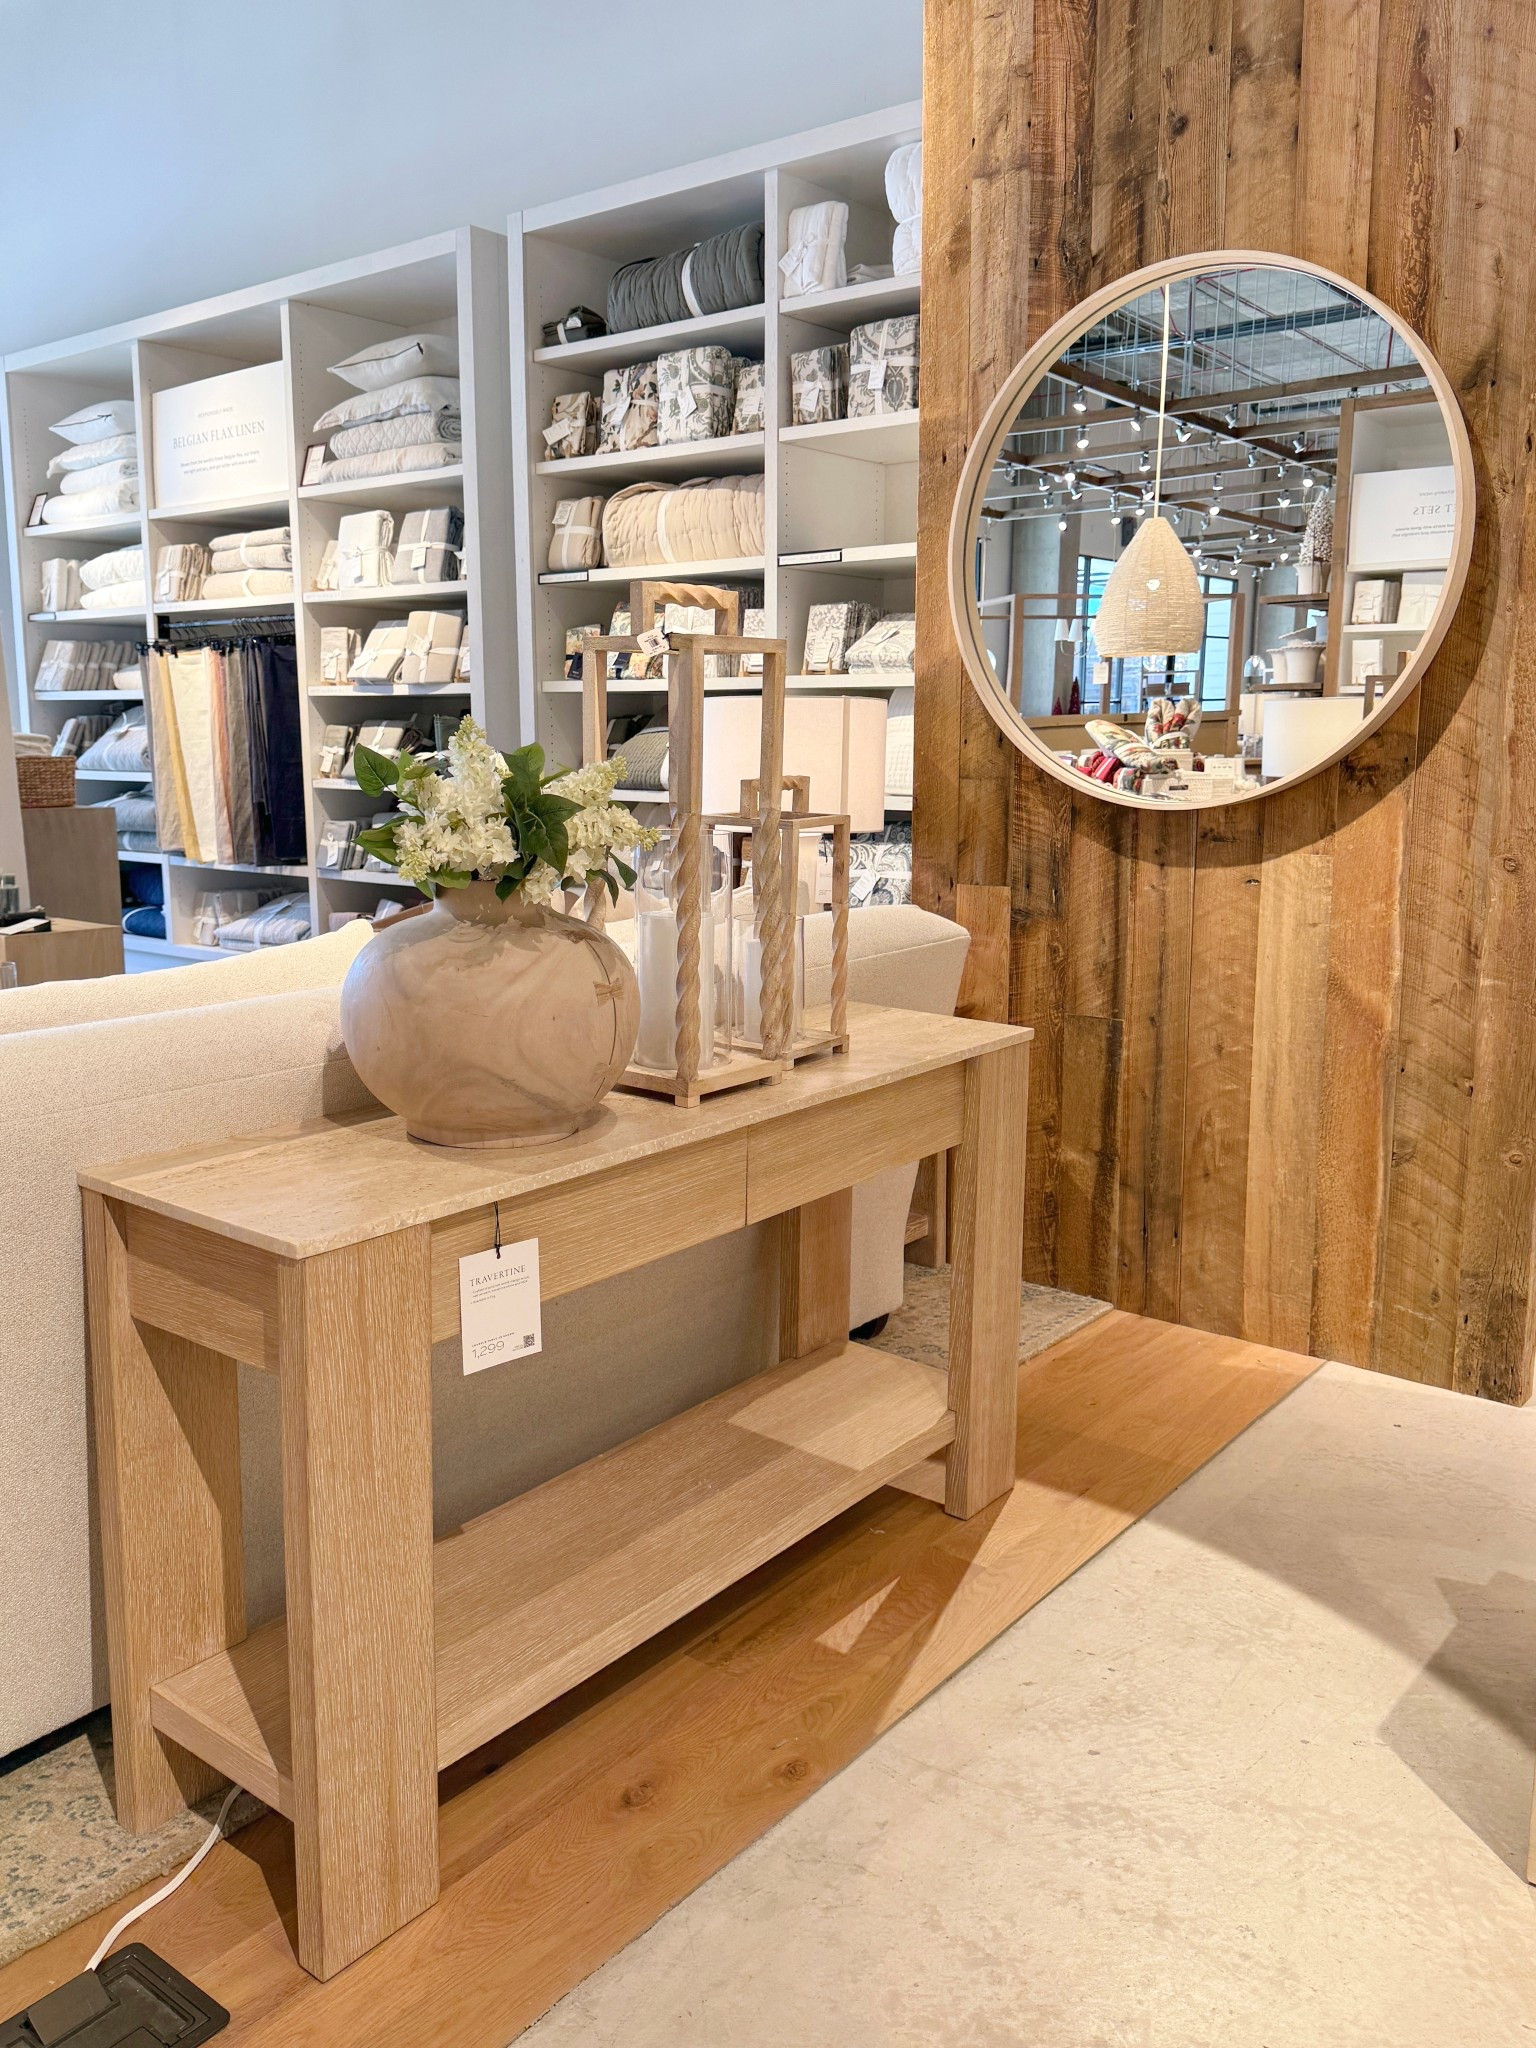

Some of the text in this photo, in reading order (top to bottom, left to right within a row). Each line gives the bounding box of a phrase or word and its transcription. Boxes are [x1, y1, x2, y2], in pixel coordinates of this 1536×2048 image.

[173, 420, 265, 449] BELGIAN FLAX LINEN
[469, 1264, 526, 1287] TRAVERTINE
[472, 1340, 505, 1359] 1,299
